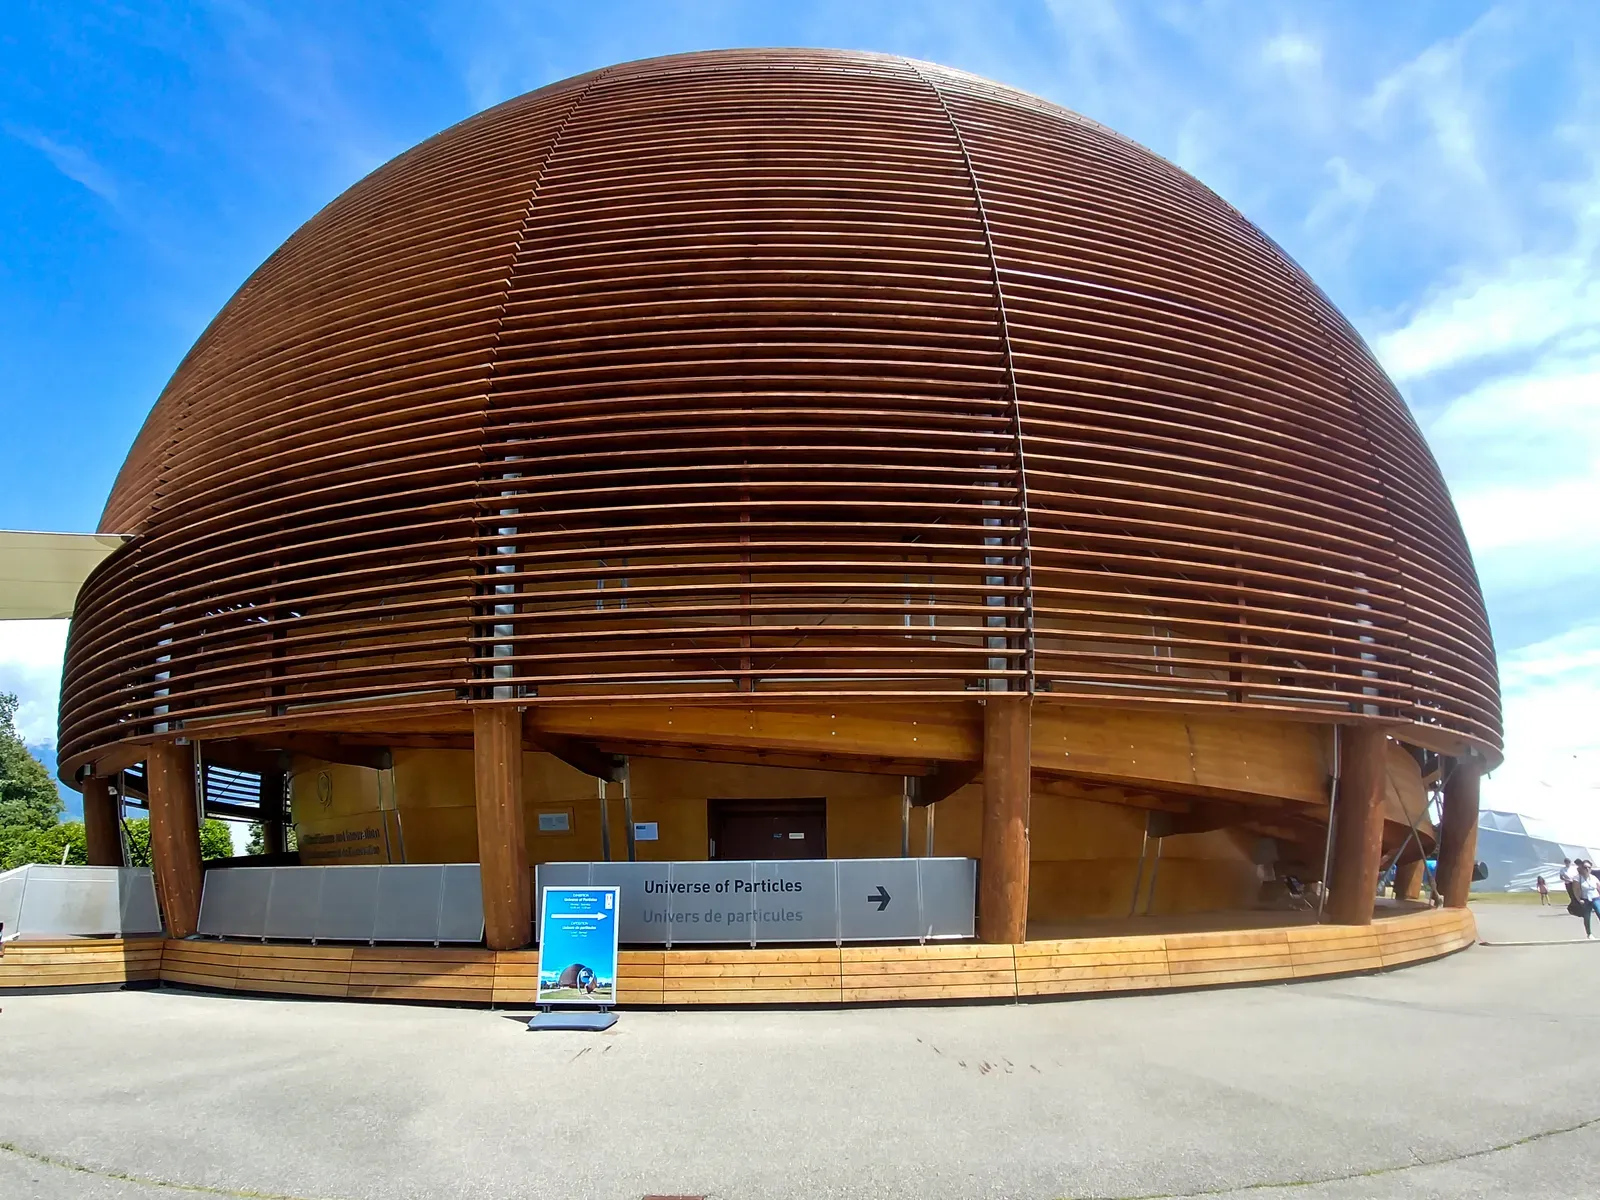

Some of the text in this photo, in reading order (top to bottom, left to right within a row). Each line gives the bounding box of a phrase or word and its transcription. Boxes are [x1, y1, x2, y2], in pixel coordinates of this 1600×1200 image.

[644, 878, 803, 894] Universe of Particles
[643, 907, 803, 926] Univers de particules
